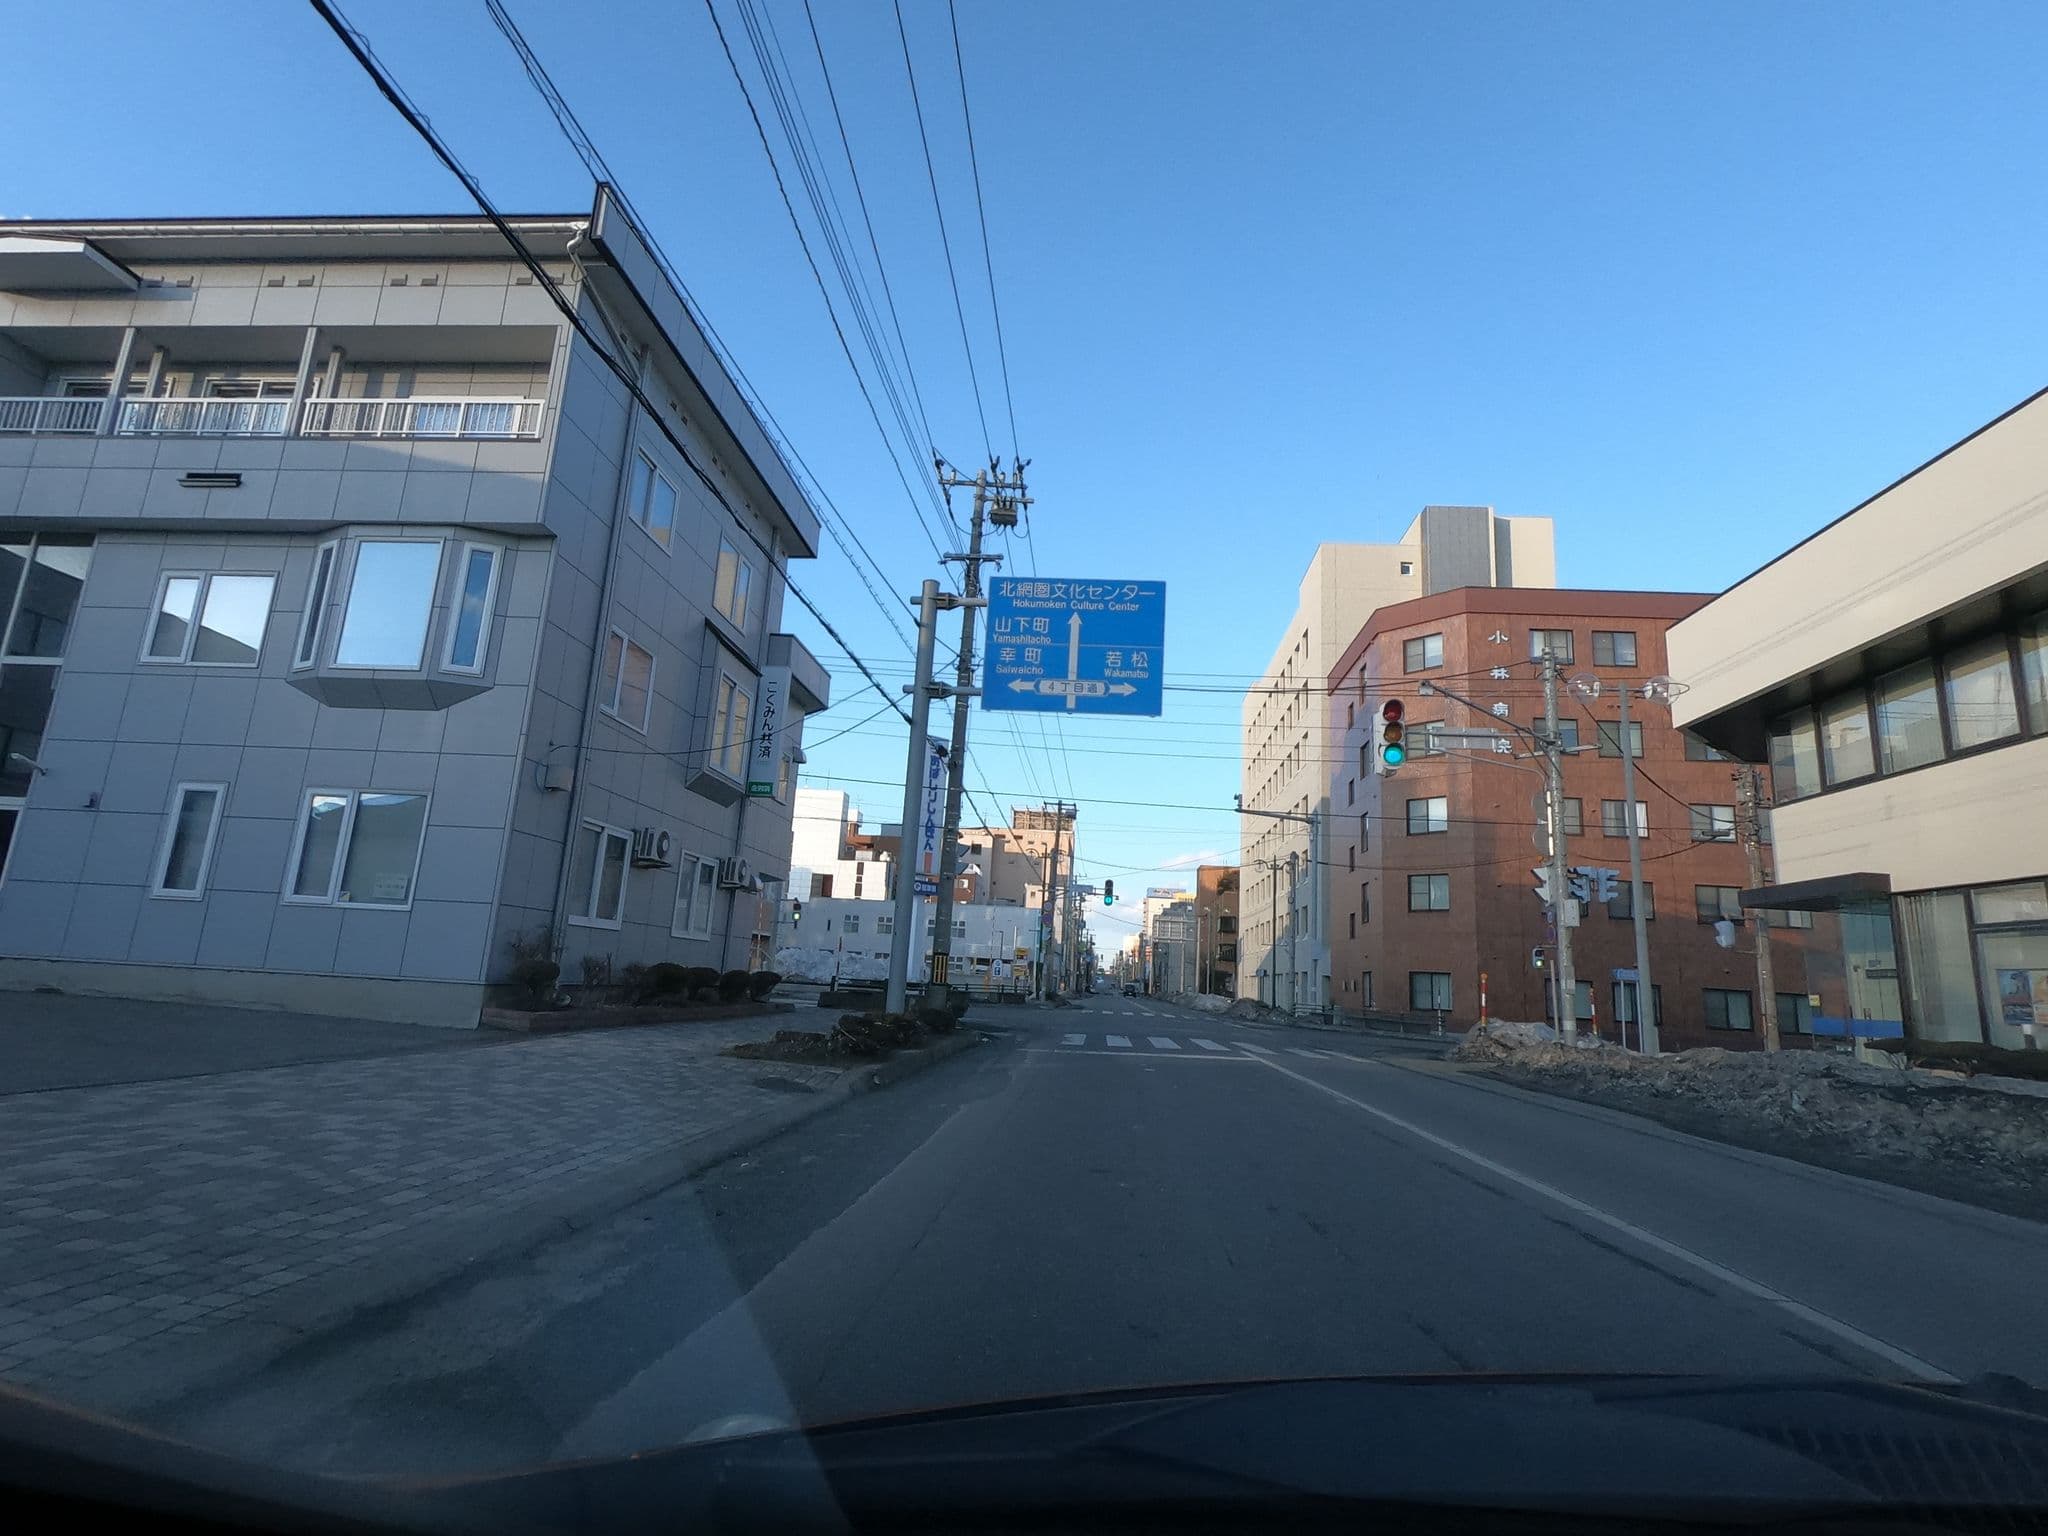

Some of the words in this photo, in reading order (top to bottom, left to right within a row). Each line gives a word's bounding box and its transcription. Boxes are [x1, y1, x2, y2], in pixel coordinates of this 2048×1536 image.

[1000, 581, 1156, 600] 北網圏文化センター
[1013, 599, 1066, 609] Hokumoken
[1071, 601, 1104, 610] Culture
[1108, 602, 1140, 611] Center
[995, 616, 1050, 633] 山下町
[993, 633, 1052, 645] Yamashitacho
[1000, 647, 1041, 664] 幸町
[1104, 650, 1149, 668] 若松
[996, 664, 1044, 675] Saiwaicho
[1104, 668, 1149, 679] Wakamatsu
[1488, 630, 1512, 754] 小林病院
[758, 681, 778, 759] こくみん共済
